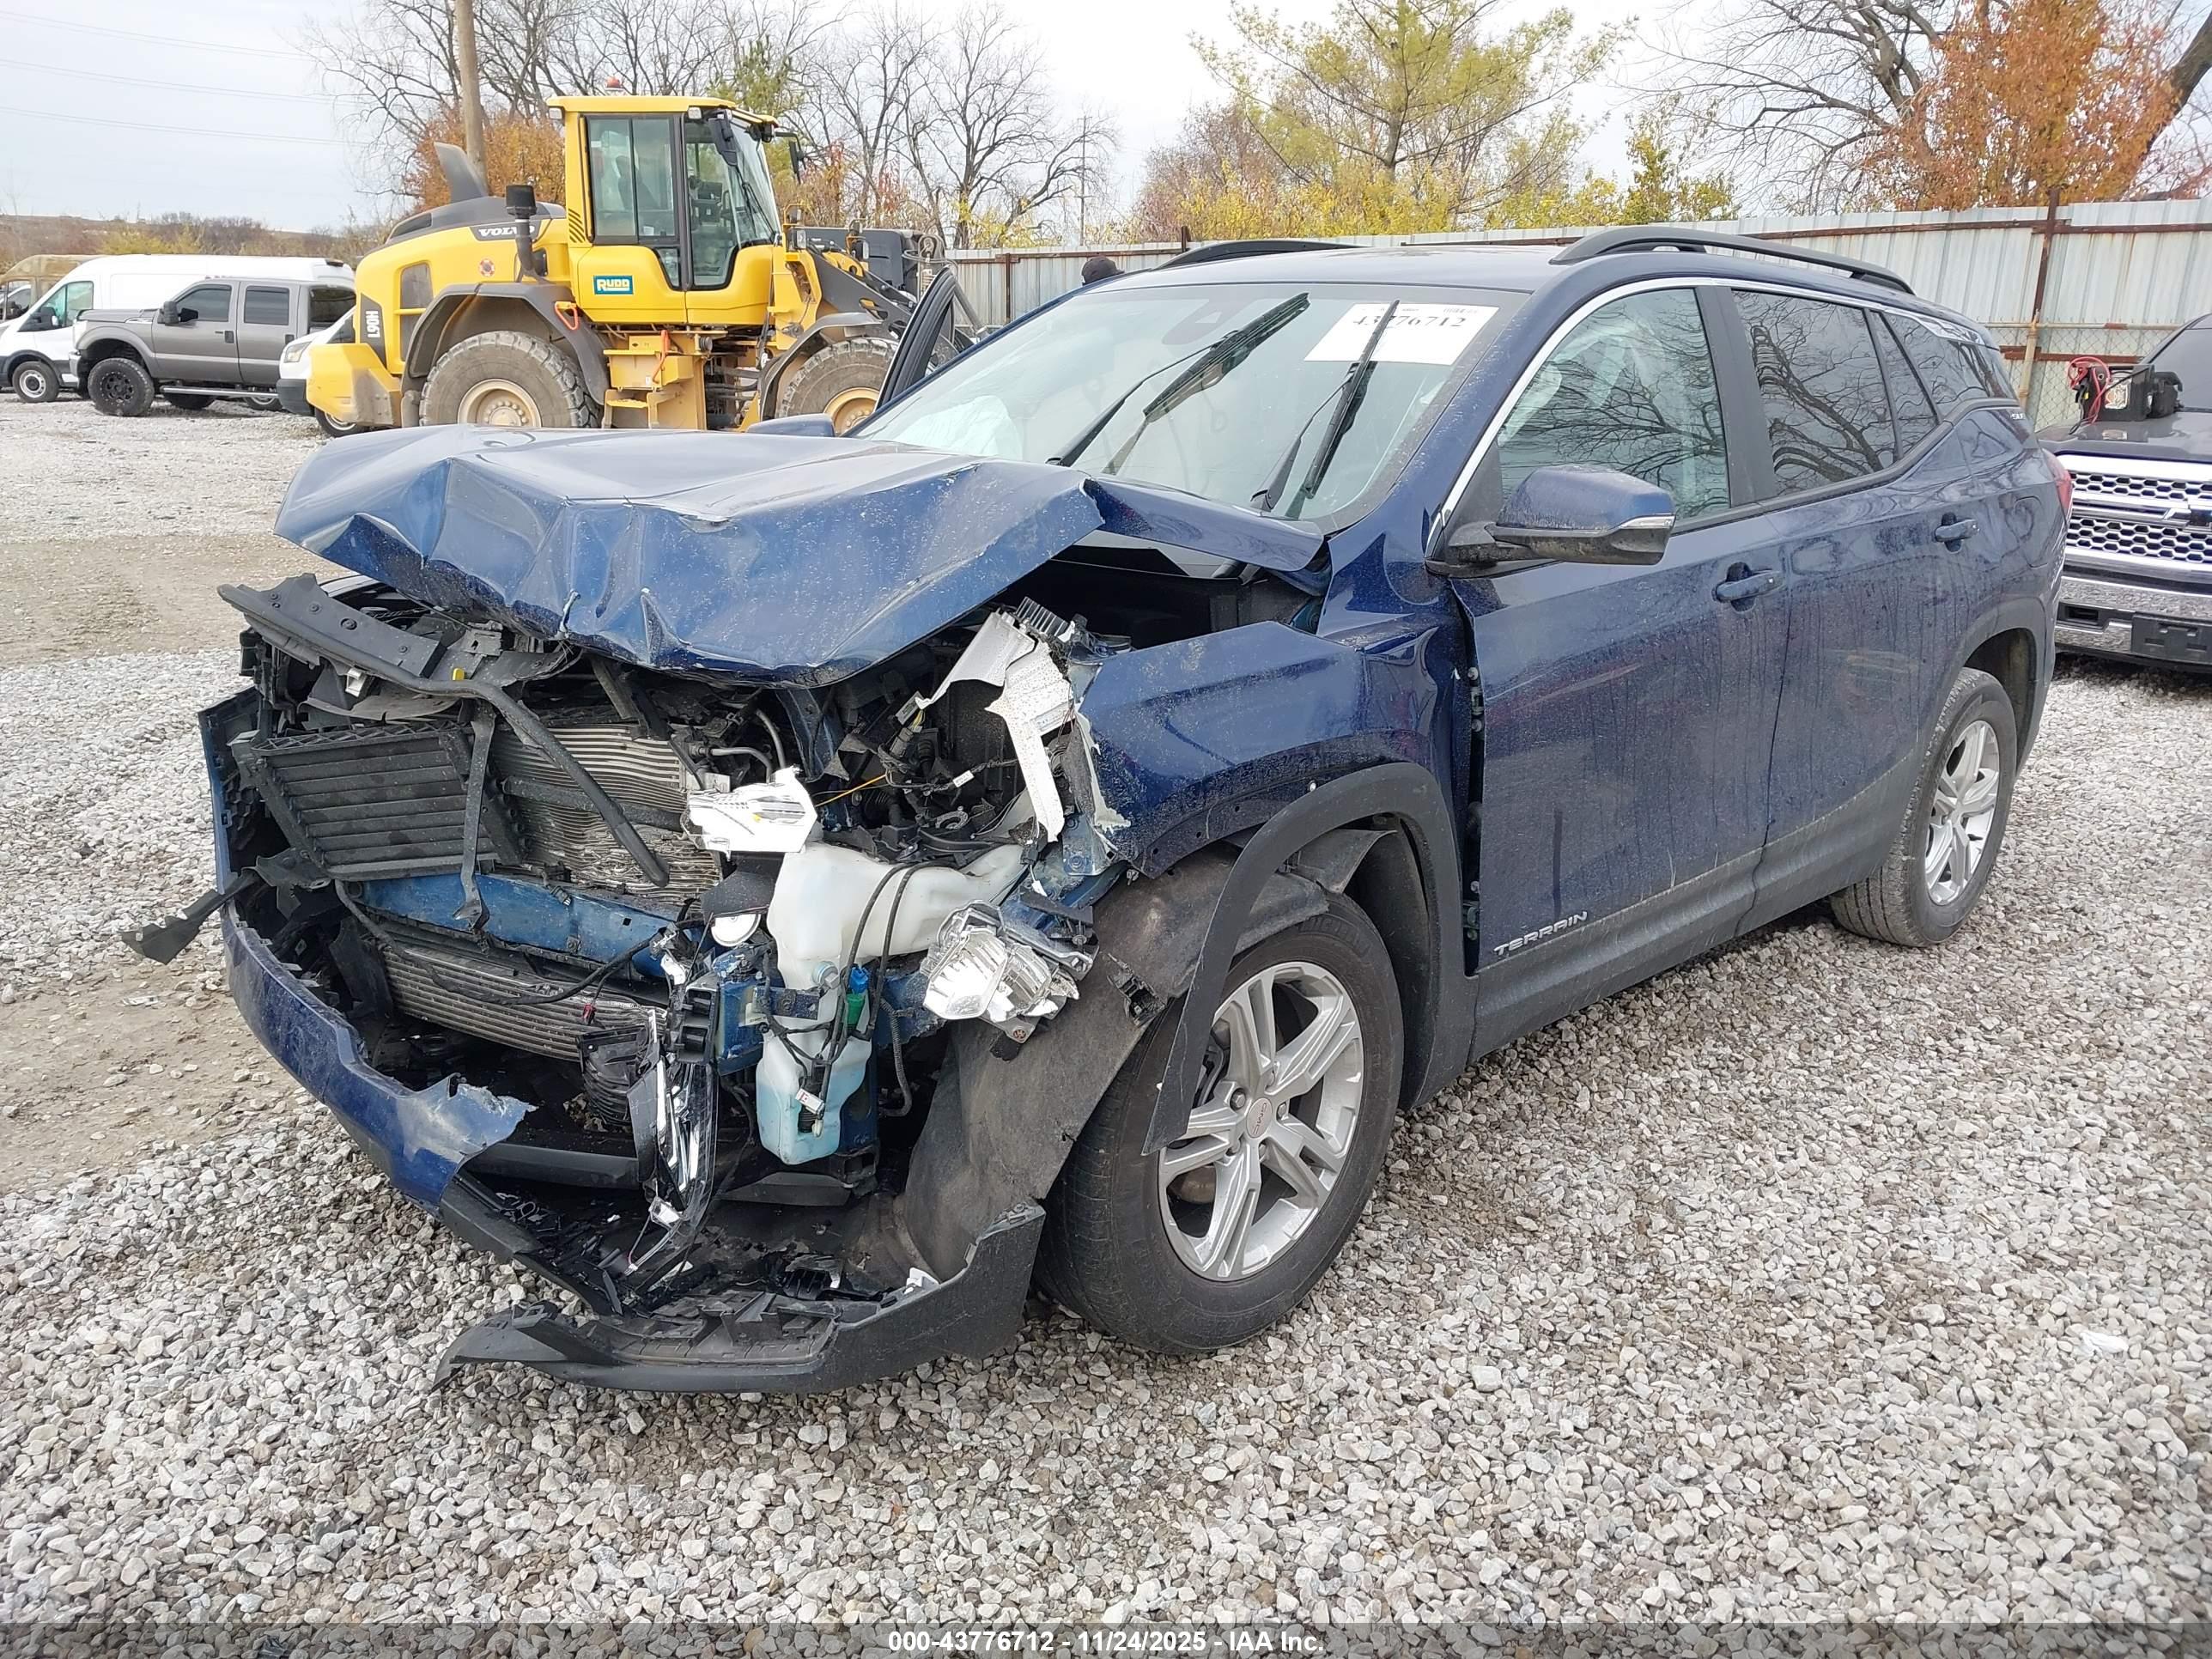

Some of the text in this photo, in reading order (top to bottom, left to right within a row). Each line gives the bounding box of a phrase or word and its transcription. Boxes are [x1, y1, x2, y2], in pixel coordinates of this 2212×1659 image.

[596, 278, 630, 291] RUDD
[365, 310, 380, 338] L90H
[1493, 910, 1588, 956] TERRAIN
[1252, 1102, 1267, 1134] GMC
